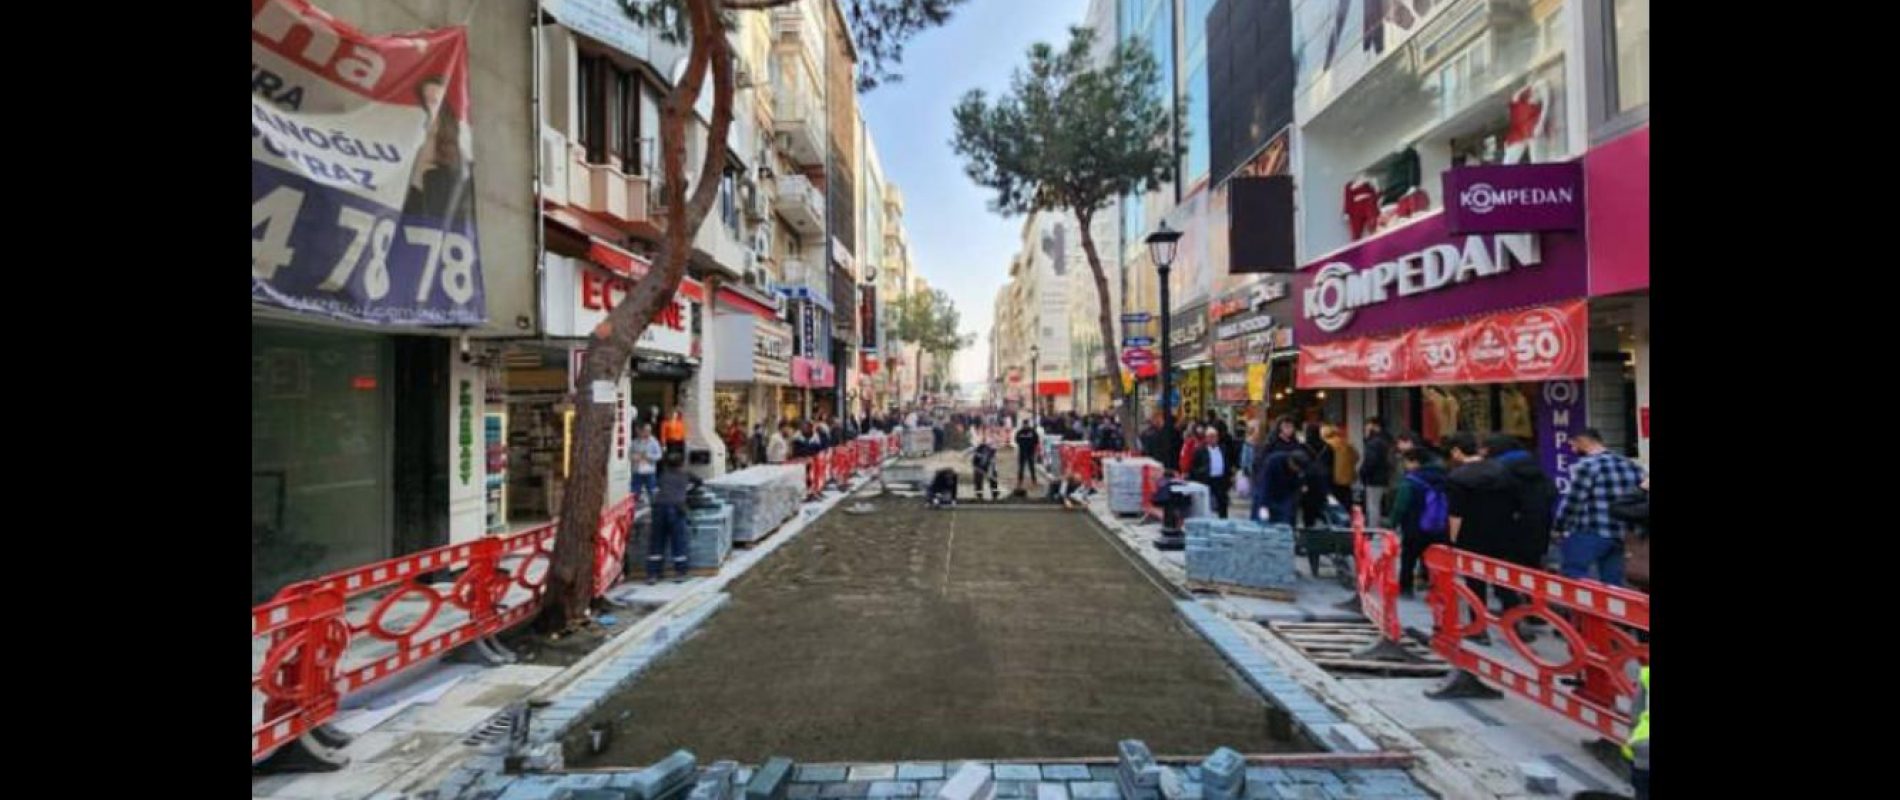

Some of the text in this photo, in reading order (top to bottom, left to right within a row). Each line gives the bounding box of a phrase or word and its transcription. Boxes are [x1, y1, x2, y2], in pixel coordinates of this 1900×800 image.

[252, 62, 304, 112] RA
[1460, 182, 1573, 214] KOMPEDAN
[317, 206, 398, 300] 78
[404, 225, 475, 305] 78
[1303, 231, 1542, 333] KOMPEDAN
[582, 267, 686, 334] ECNE
[1514, 329, 1560, 361] 50
